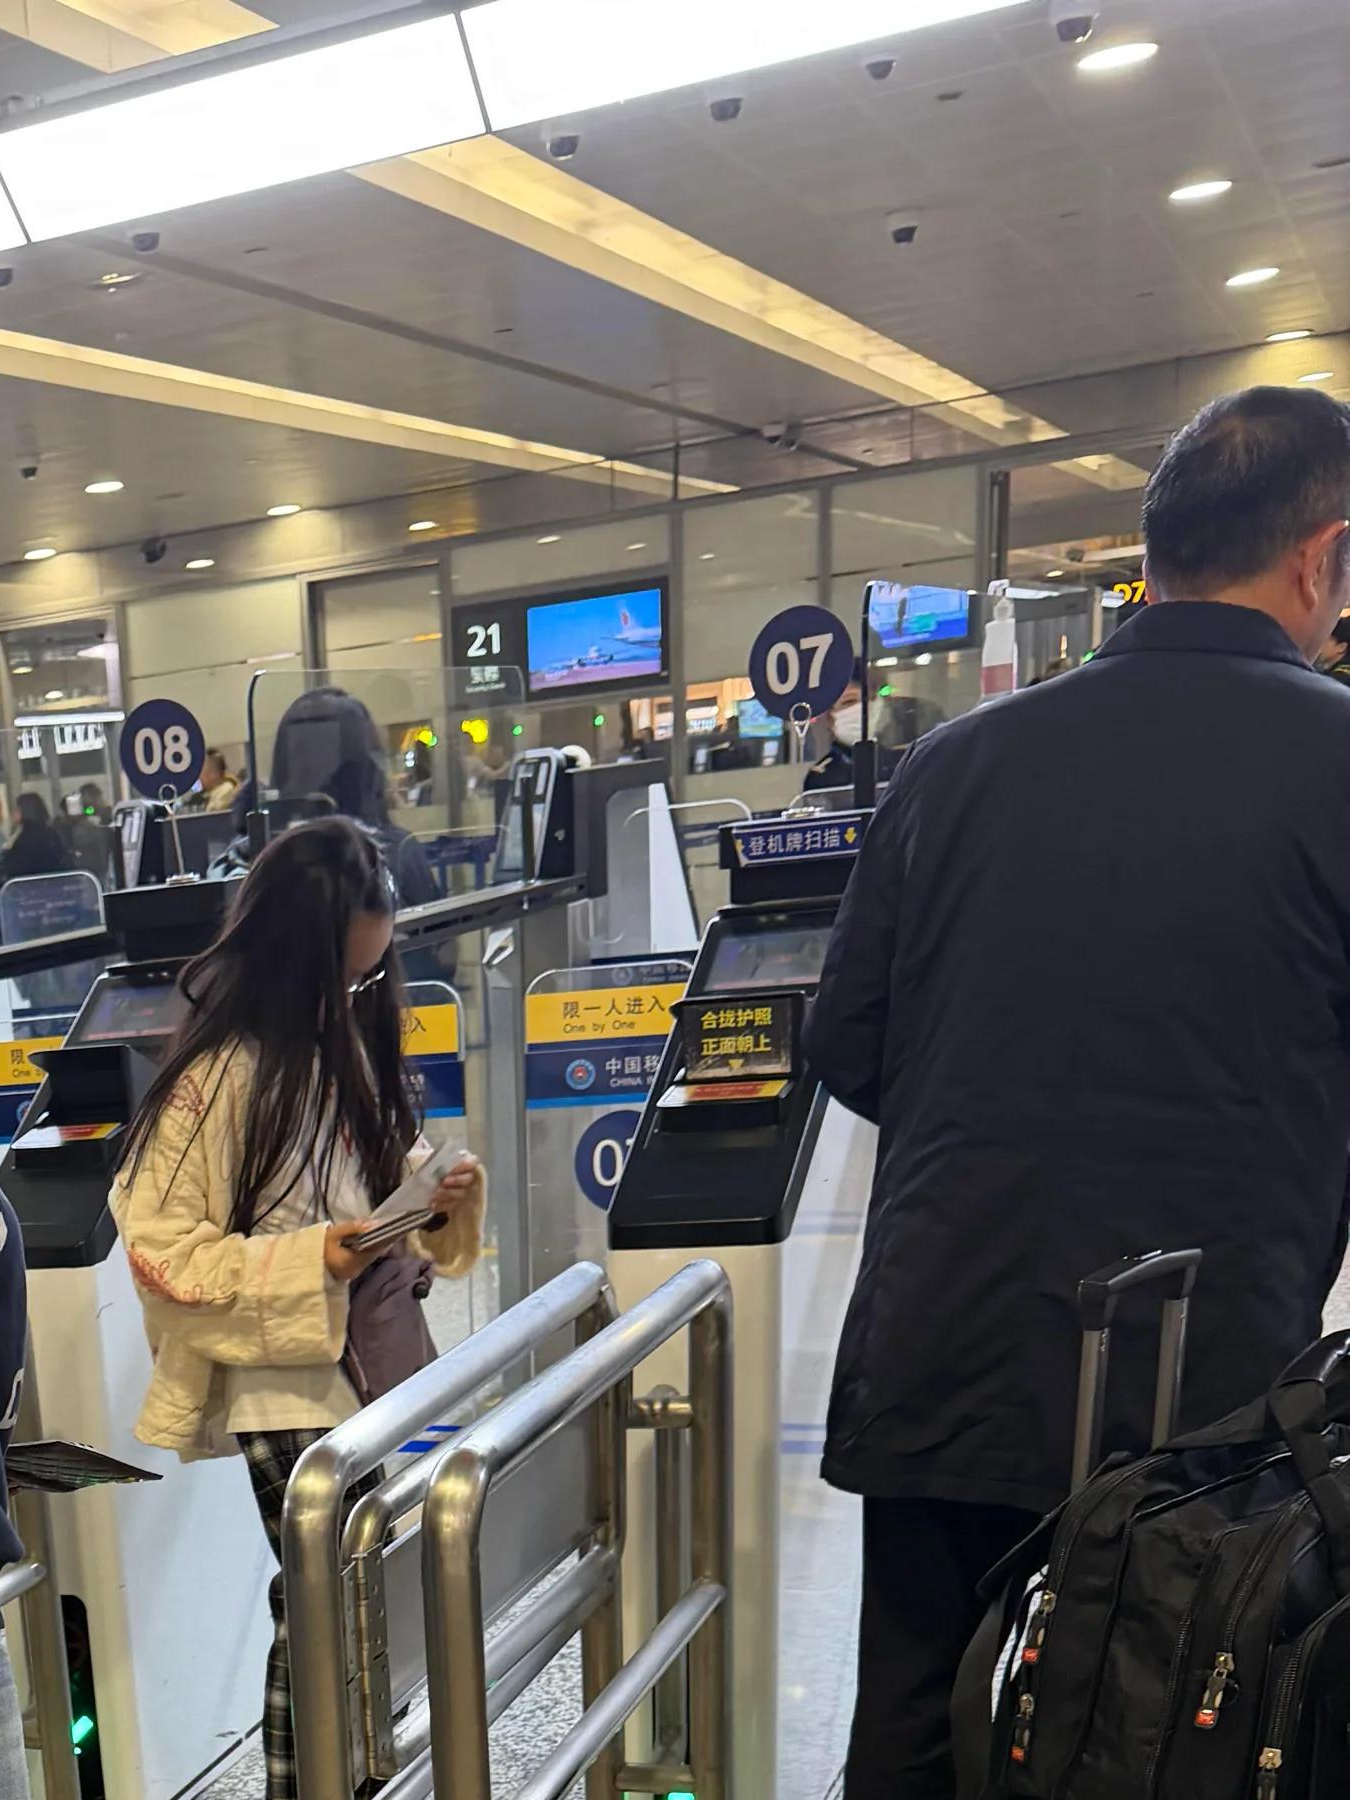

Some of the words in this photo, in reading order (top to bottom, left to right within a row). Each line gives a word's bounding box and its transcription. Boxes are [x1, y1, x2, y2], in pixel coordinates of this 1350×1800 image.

[466, 622, 501, 657] 21
[766, 633, 834, 695] 07
[134, 725, 192, 775] 08
[749, 827, 841, 857] 登机牌扫描
[562, 994, 666, 1020] 限一人进入
[700, 1007, 773, 1030] 合拢护照
[563, 1022, 586, 1034] One
[592, 1022, 606, 1033] by
[612, 1019, 636, 1031] One
[700, 1034, 772, 1057] 正面朝上
[593, 1137, 635, 1187] 0
